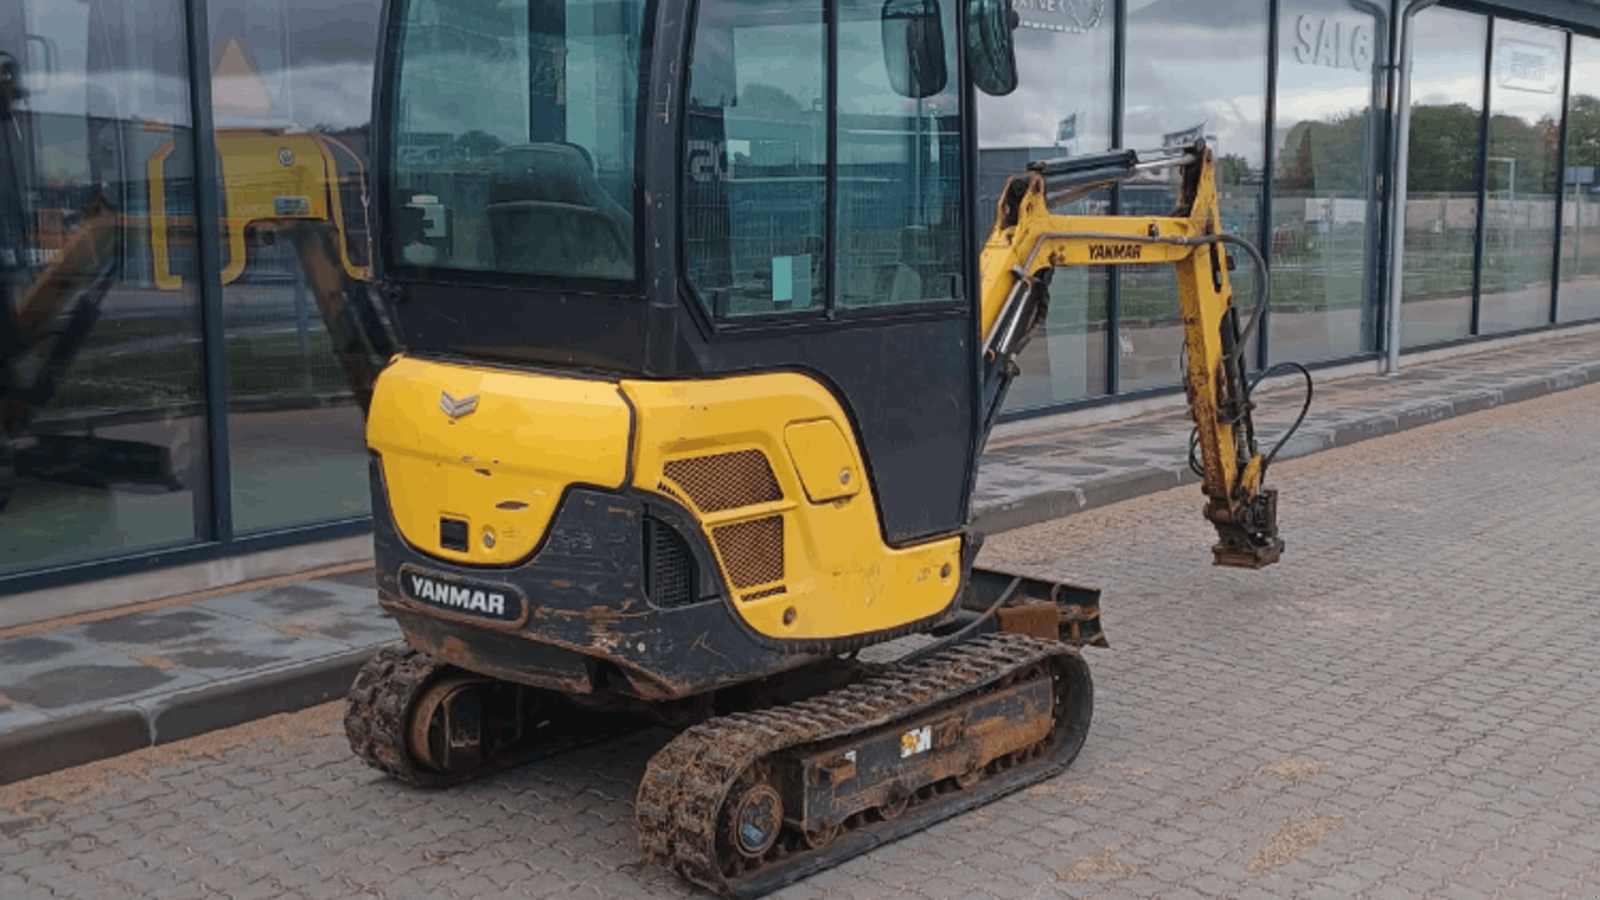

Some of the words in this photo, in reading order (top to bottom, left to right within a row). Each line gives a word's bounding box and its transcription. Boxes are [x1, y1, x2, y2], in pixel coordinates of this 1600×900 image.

[1293, 13, 1372, 72] SALG
[1088, 244, 1142, 260] YANMAR
[411, 575, 505, 615] YANMAR
